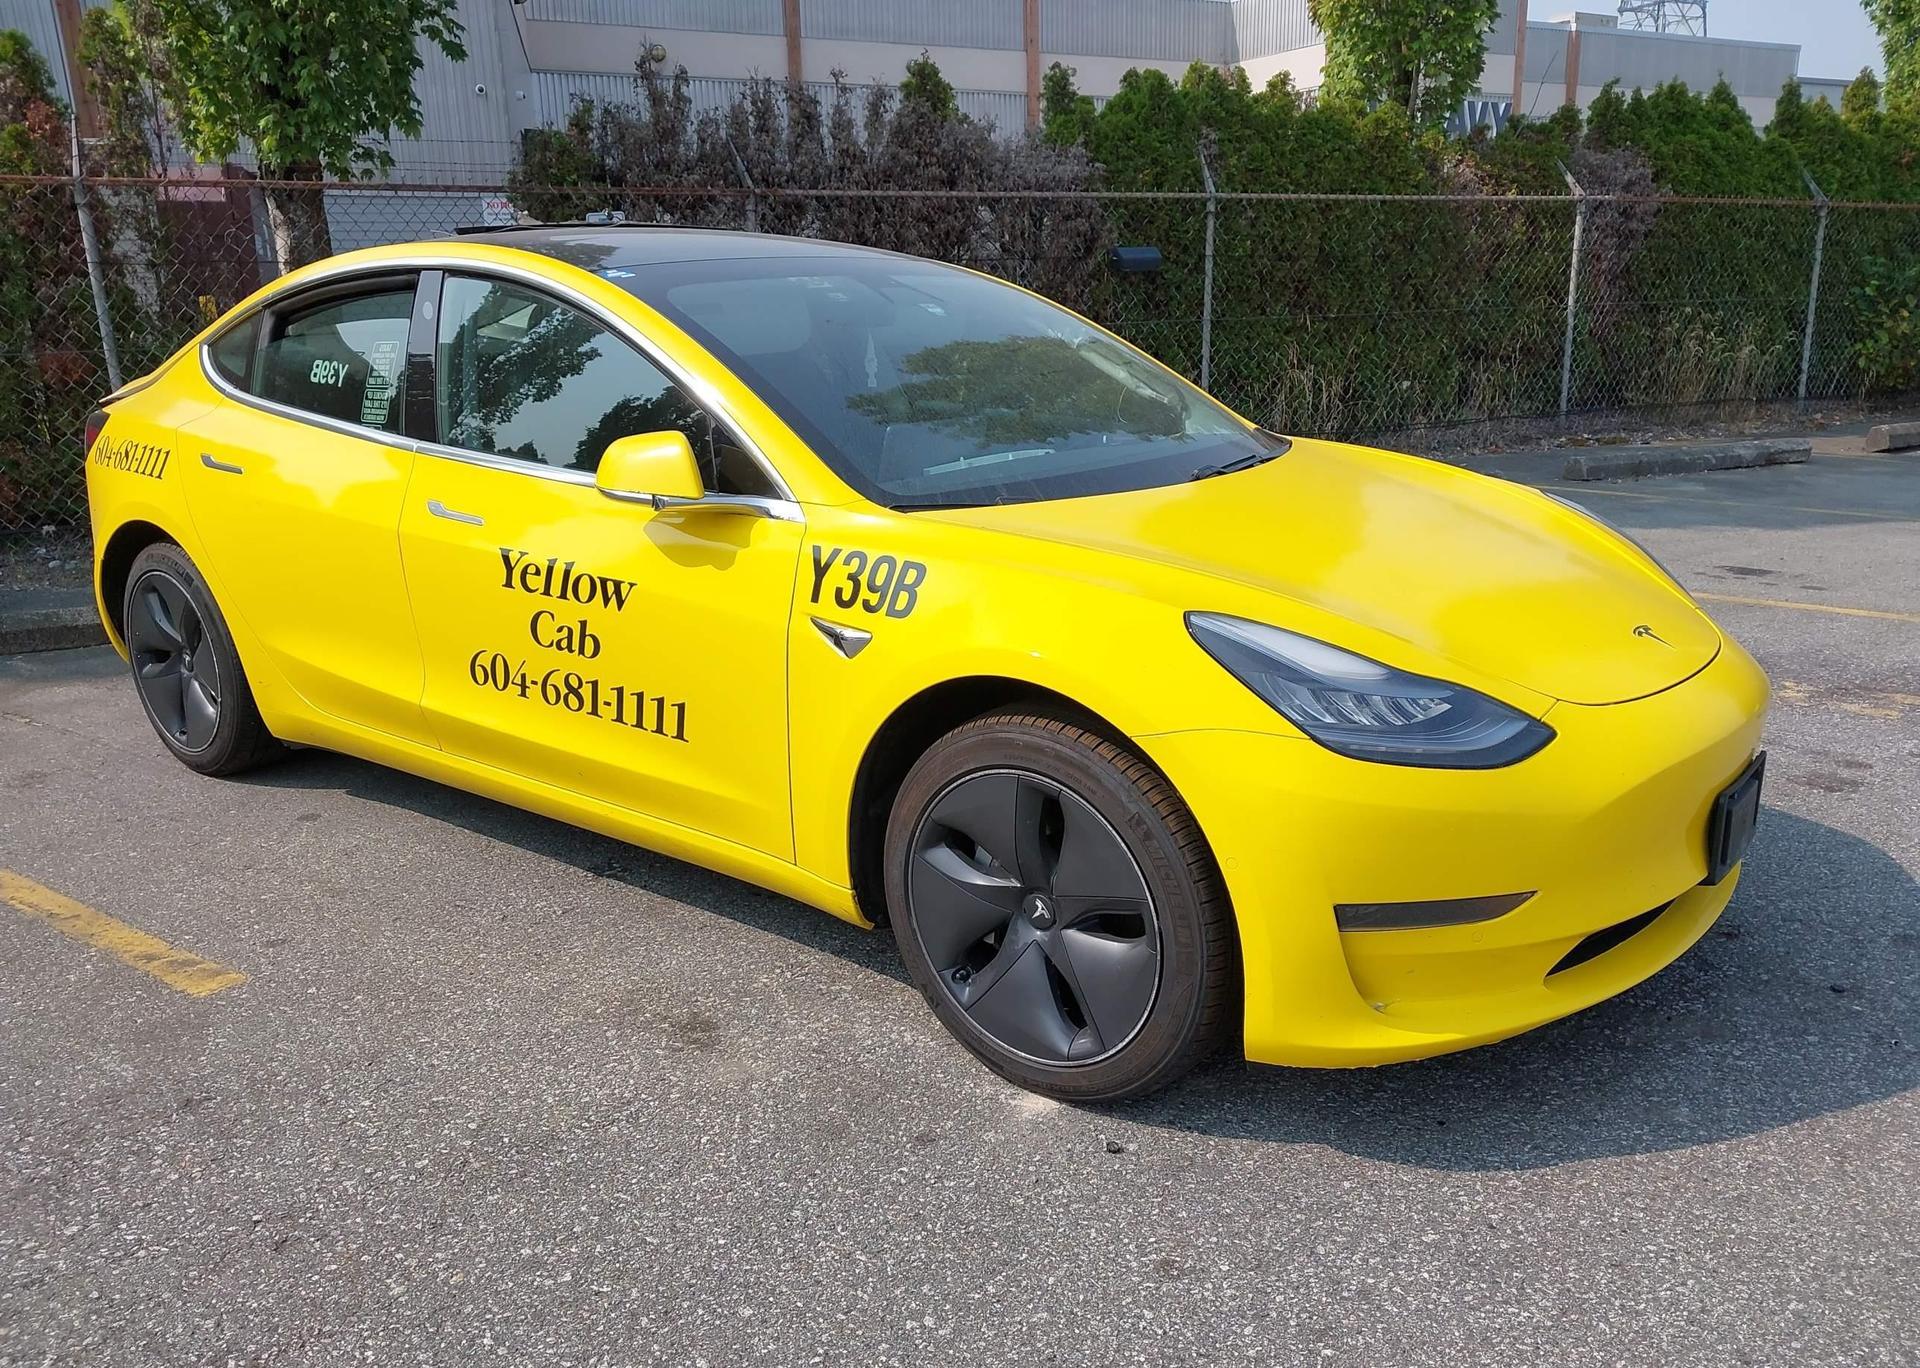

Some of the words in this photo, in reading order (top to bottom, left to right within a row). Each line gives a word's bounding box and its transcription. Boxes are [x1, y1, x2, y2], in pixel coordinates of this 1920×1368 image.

[499, 547, 638, 612] Yellow
[810, 544, 927, 619] Y39B
[529, 610, 601, 660] Cab
[469, 649, 689, 743] 604-681-1111
